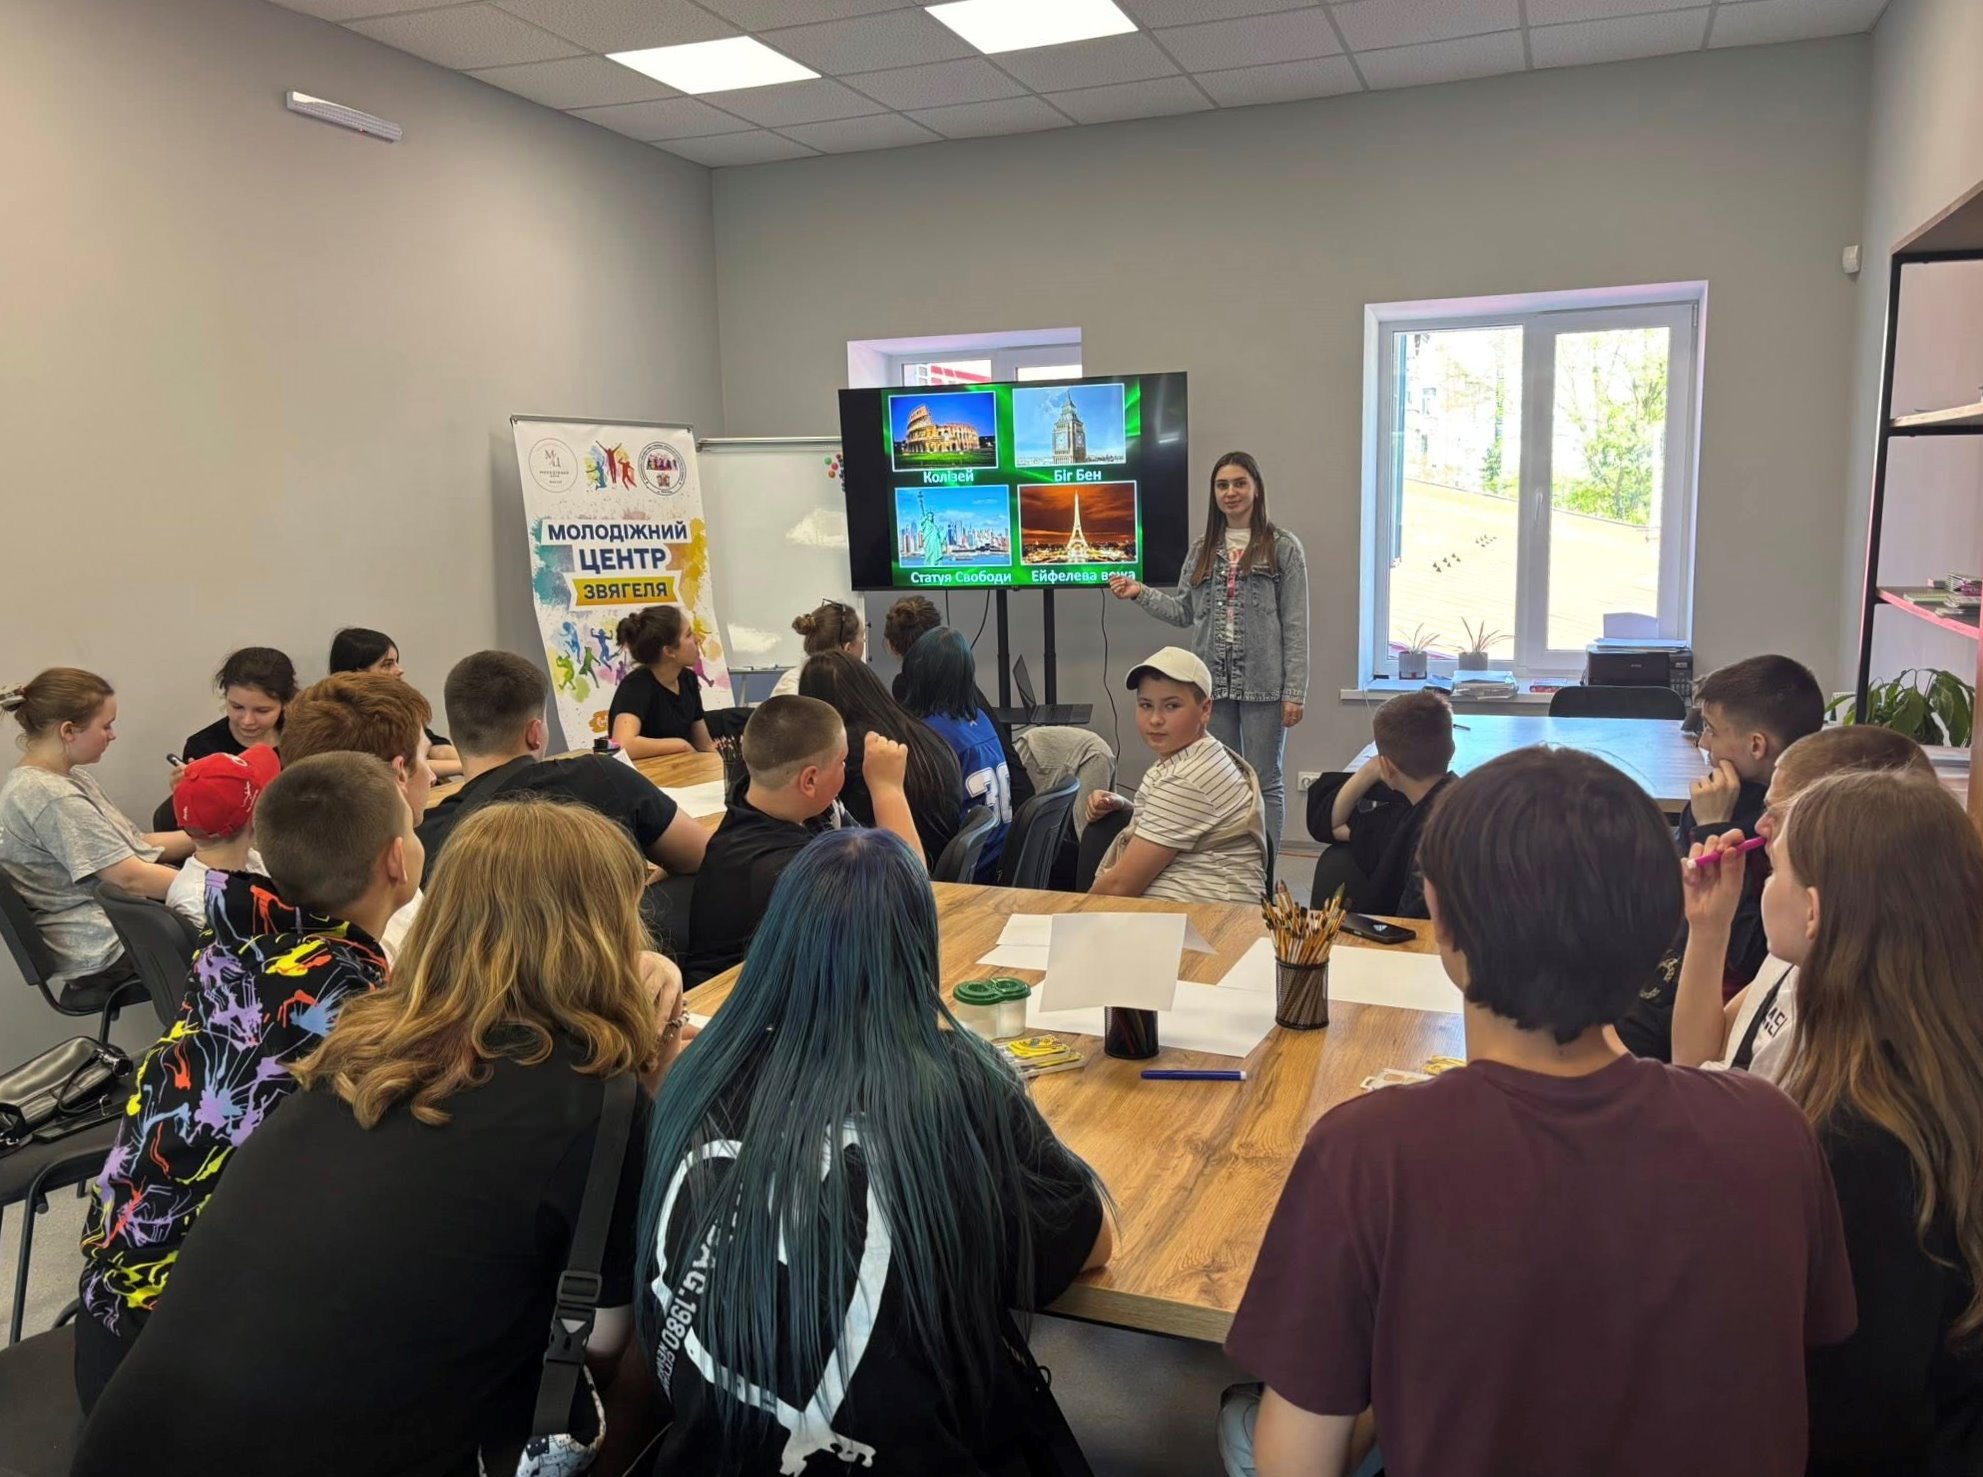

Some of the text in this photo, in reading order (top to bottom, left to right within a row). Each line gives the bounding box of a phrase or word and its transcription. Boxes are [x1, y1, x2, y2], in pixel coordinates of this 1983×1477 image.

[923, 468, 974, 483] Колізей
[1054, 468, 1102, 482] Біг Бен
[547, 521, 688, 543] МОЛОДІЖНИЙ
[579, 548, 667, 574] ЦЕНТР
[910, 570, 1012, 585] Статуя Свободи
[1031, 569, 1098, 585] Ейфелева
[583, 582, 668, 600] ЗВЯГЕЛЯ
